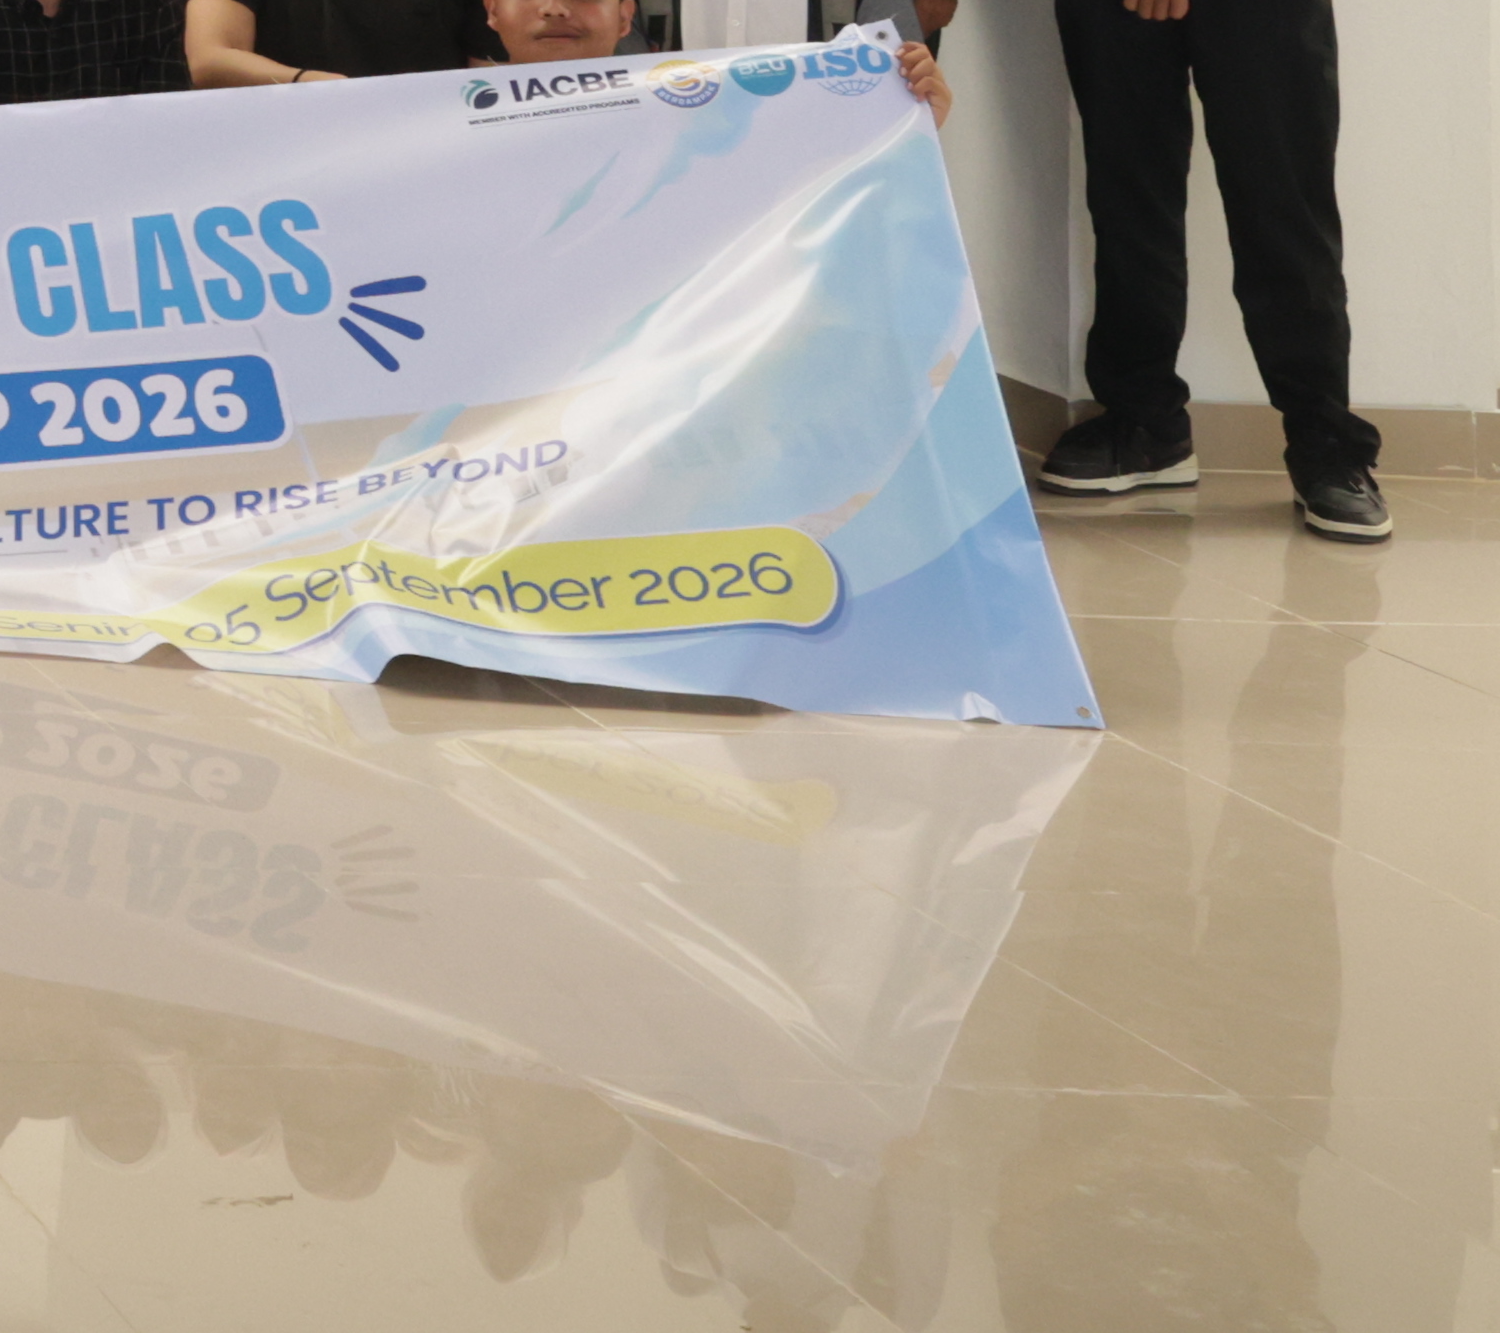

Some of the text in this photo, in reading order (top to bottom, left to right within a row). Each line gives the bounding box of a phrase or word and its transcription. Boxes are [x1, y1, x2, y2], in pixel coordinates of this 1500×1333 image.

[508, 68, 635, 103] IACBE
[802, 43, 893, 80] ISO
[7, 197, 336, 338] CLASS
[33, 367, 248, 445] 2026
[147, 494, 217, 532] TO
[234, 479, 339, 522] RISE
[357, 438, 569, 497] BEYOND
[184, 604, 262, 646] 05
[265, 558, 611, 623] September
[628, 550, 794, 607] 2026
